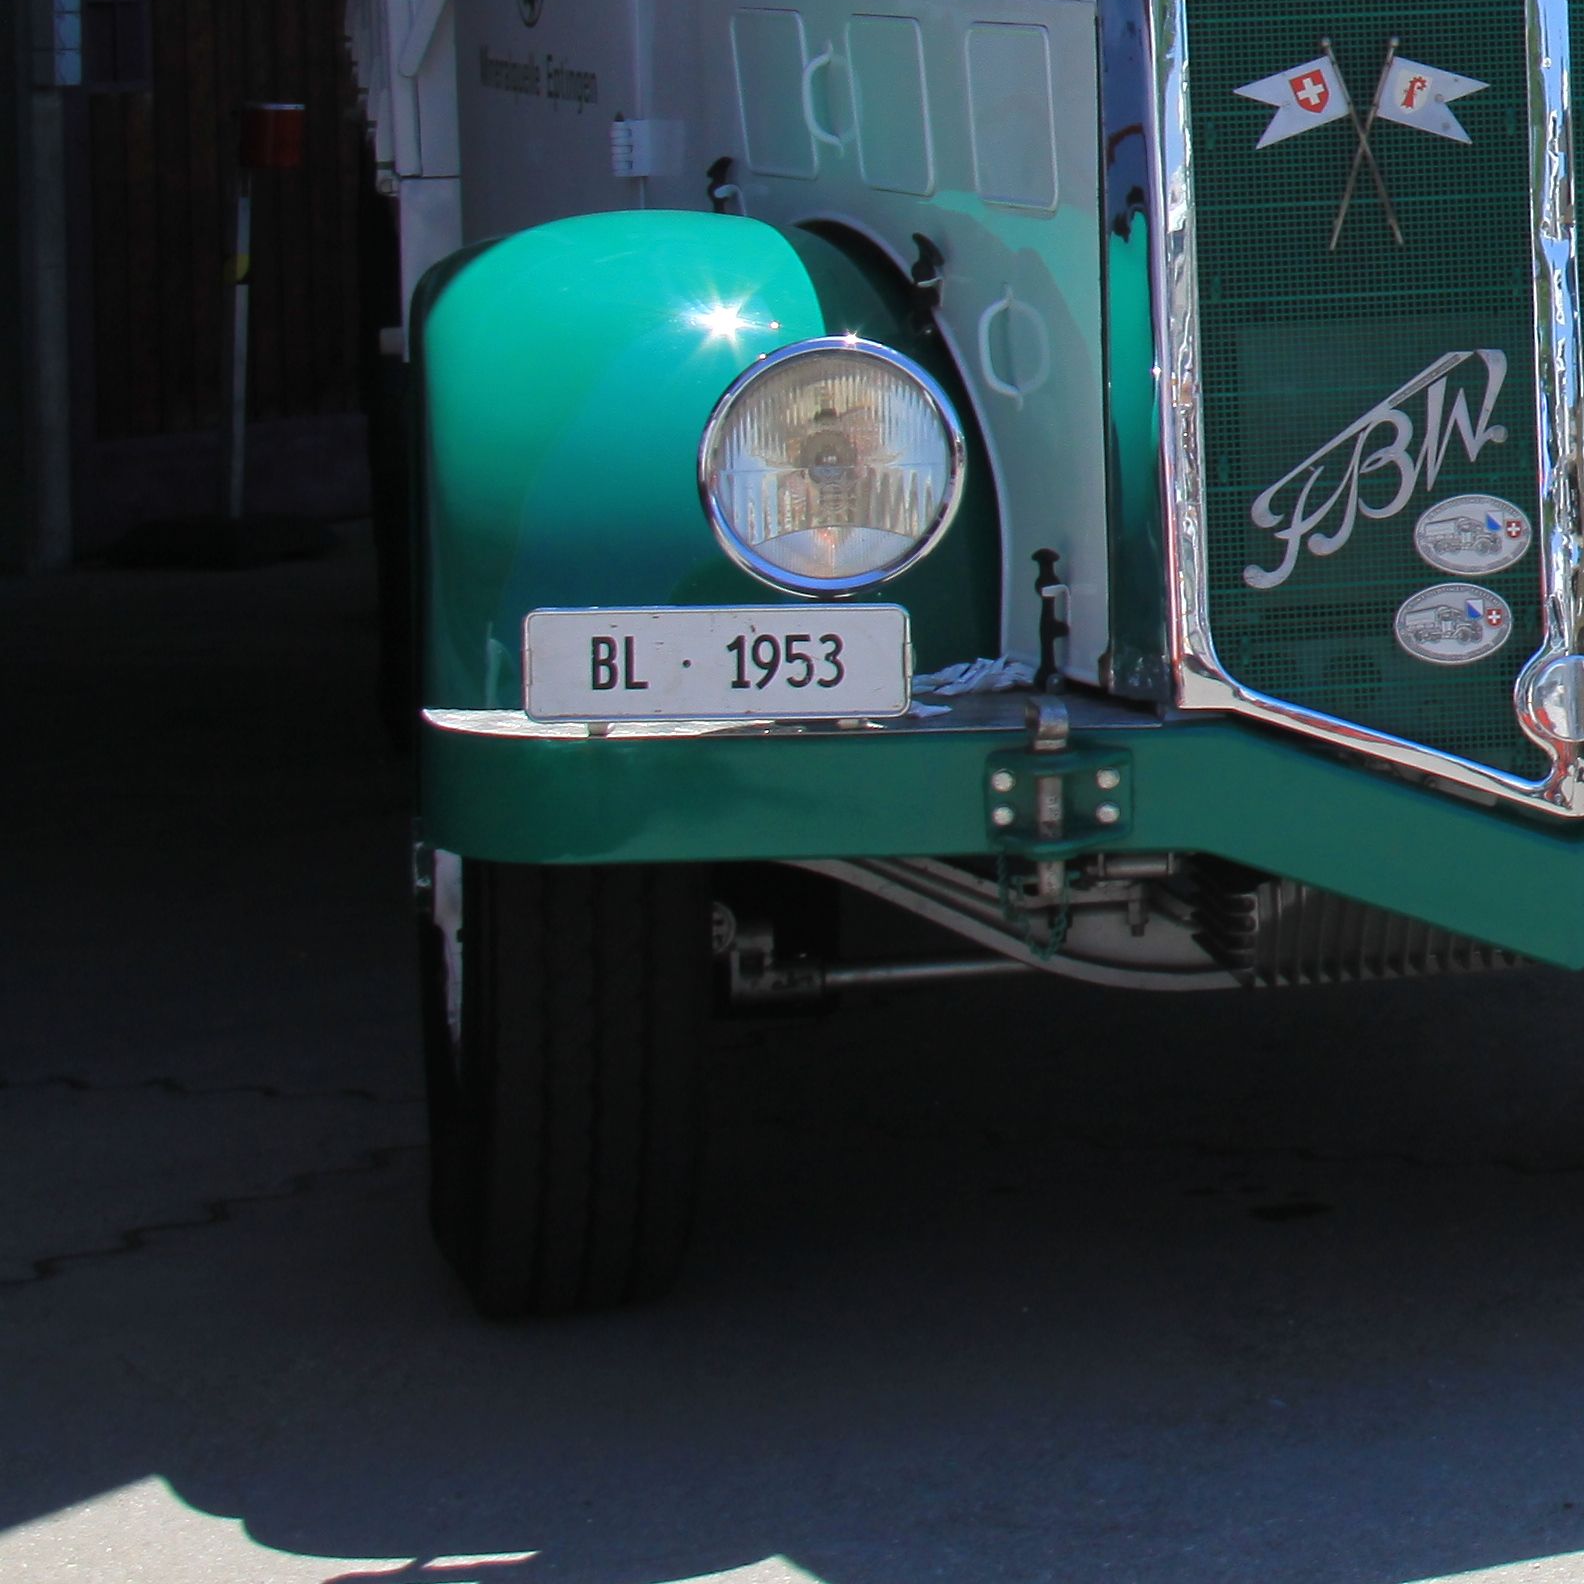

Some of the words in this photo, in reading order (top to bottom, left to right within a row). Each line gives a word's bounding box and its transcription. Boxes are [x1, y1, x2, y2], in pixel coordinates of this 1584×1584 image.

[1243, 349, 1508, 589] FBW
[590, 635, 649, 691] BL
[725, 632, 846, 691] 1953
